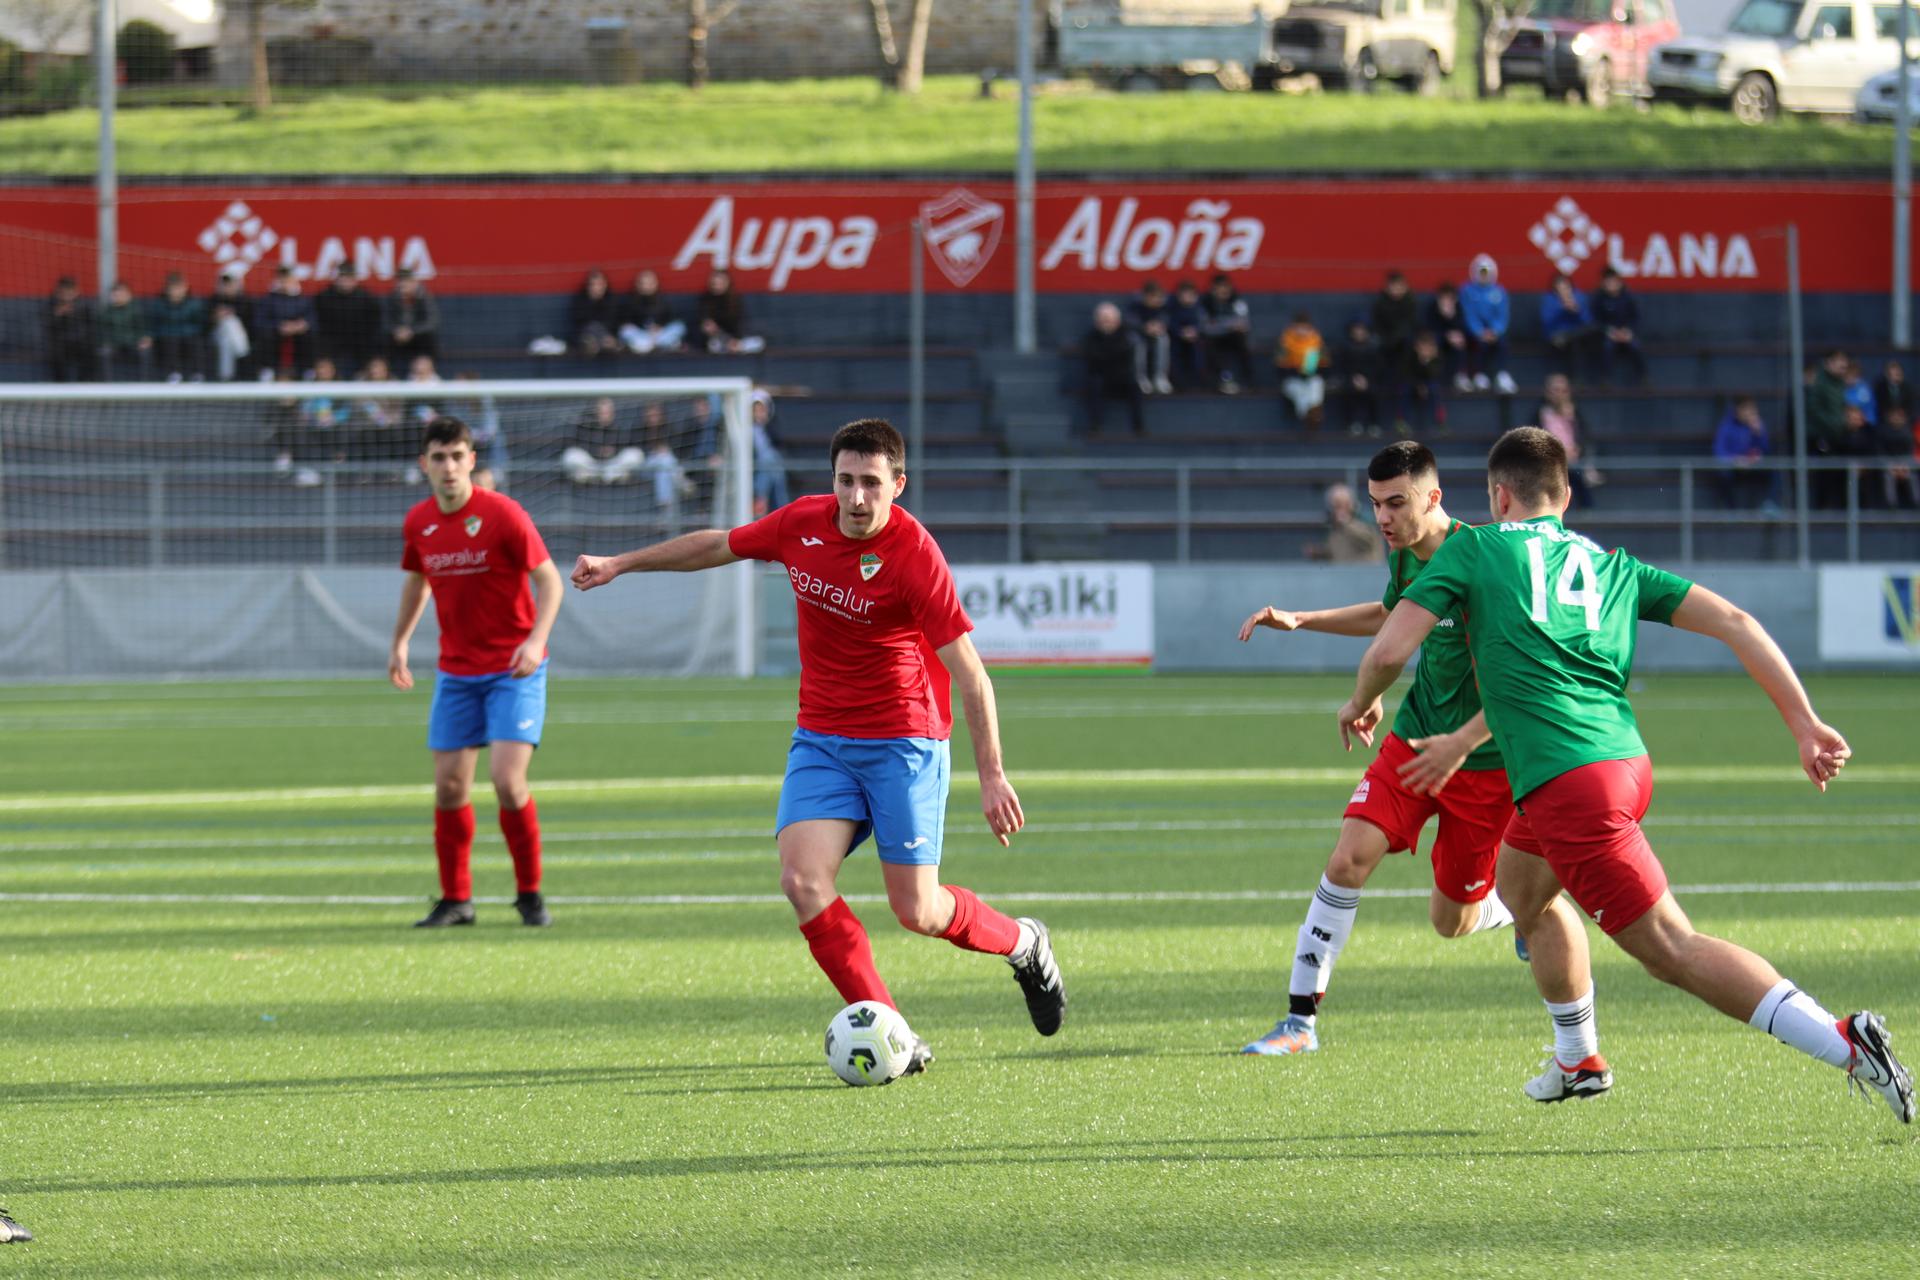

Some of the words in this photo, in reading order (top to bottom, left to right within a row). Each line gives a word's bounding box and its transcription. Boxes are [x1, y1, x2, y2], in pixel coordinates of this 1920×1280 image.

[278, 235, 436, 281] LANA
[671, 195, 878, 291] Aupa
[1040, 197, 1265, 272] Aloña
[1606, 233, 1758, 279] LANA
[789, 566, 875, 615] egaralur
[961, 573, 1118, 630] ekalki
[1524, 536, 1602, 631] 14
